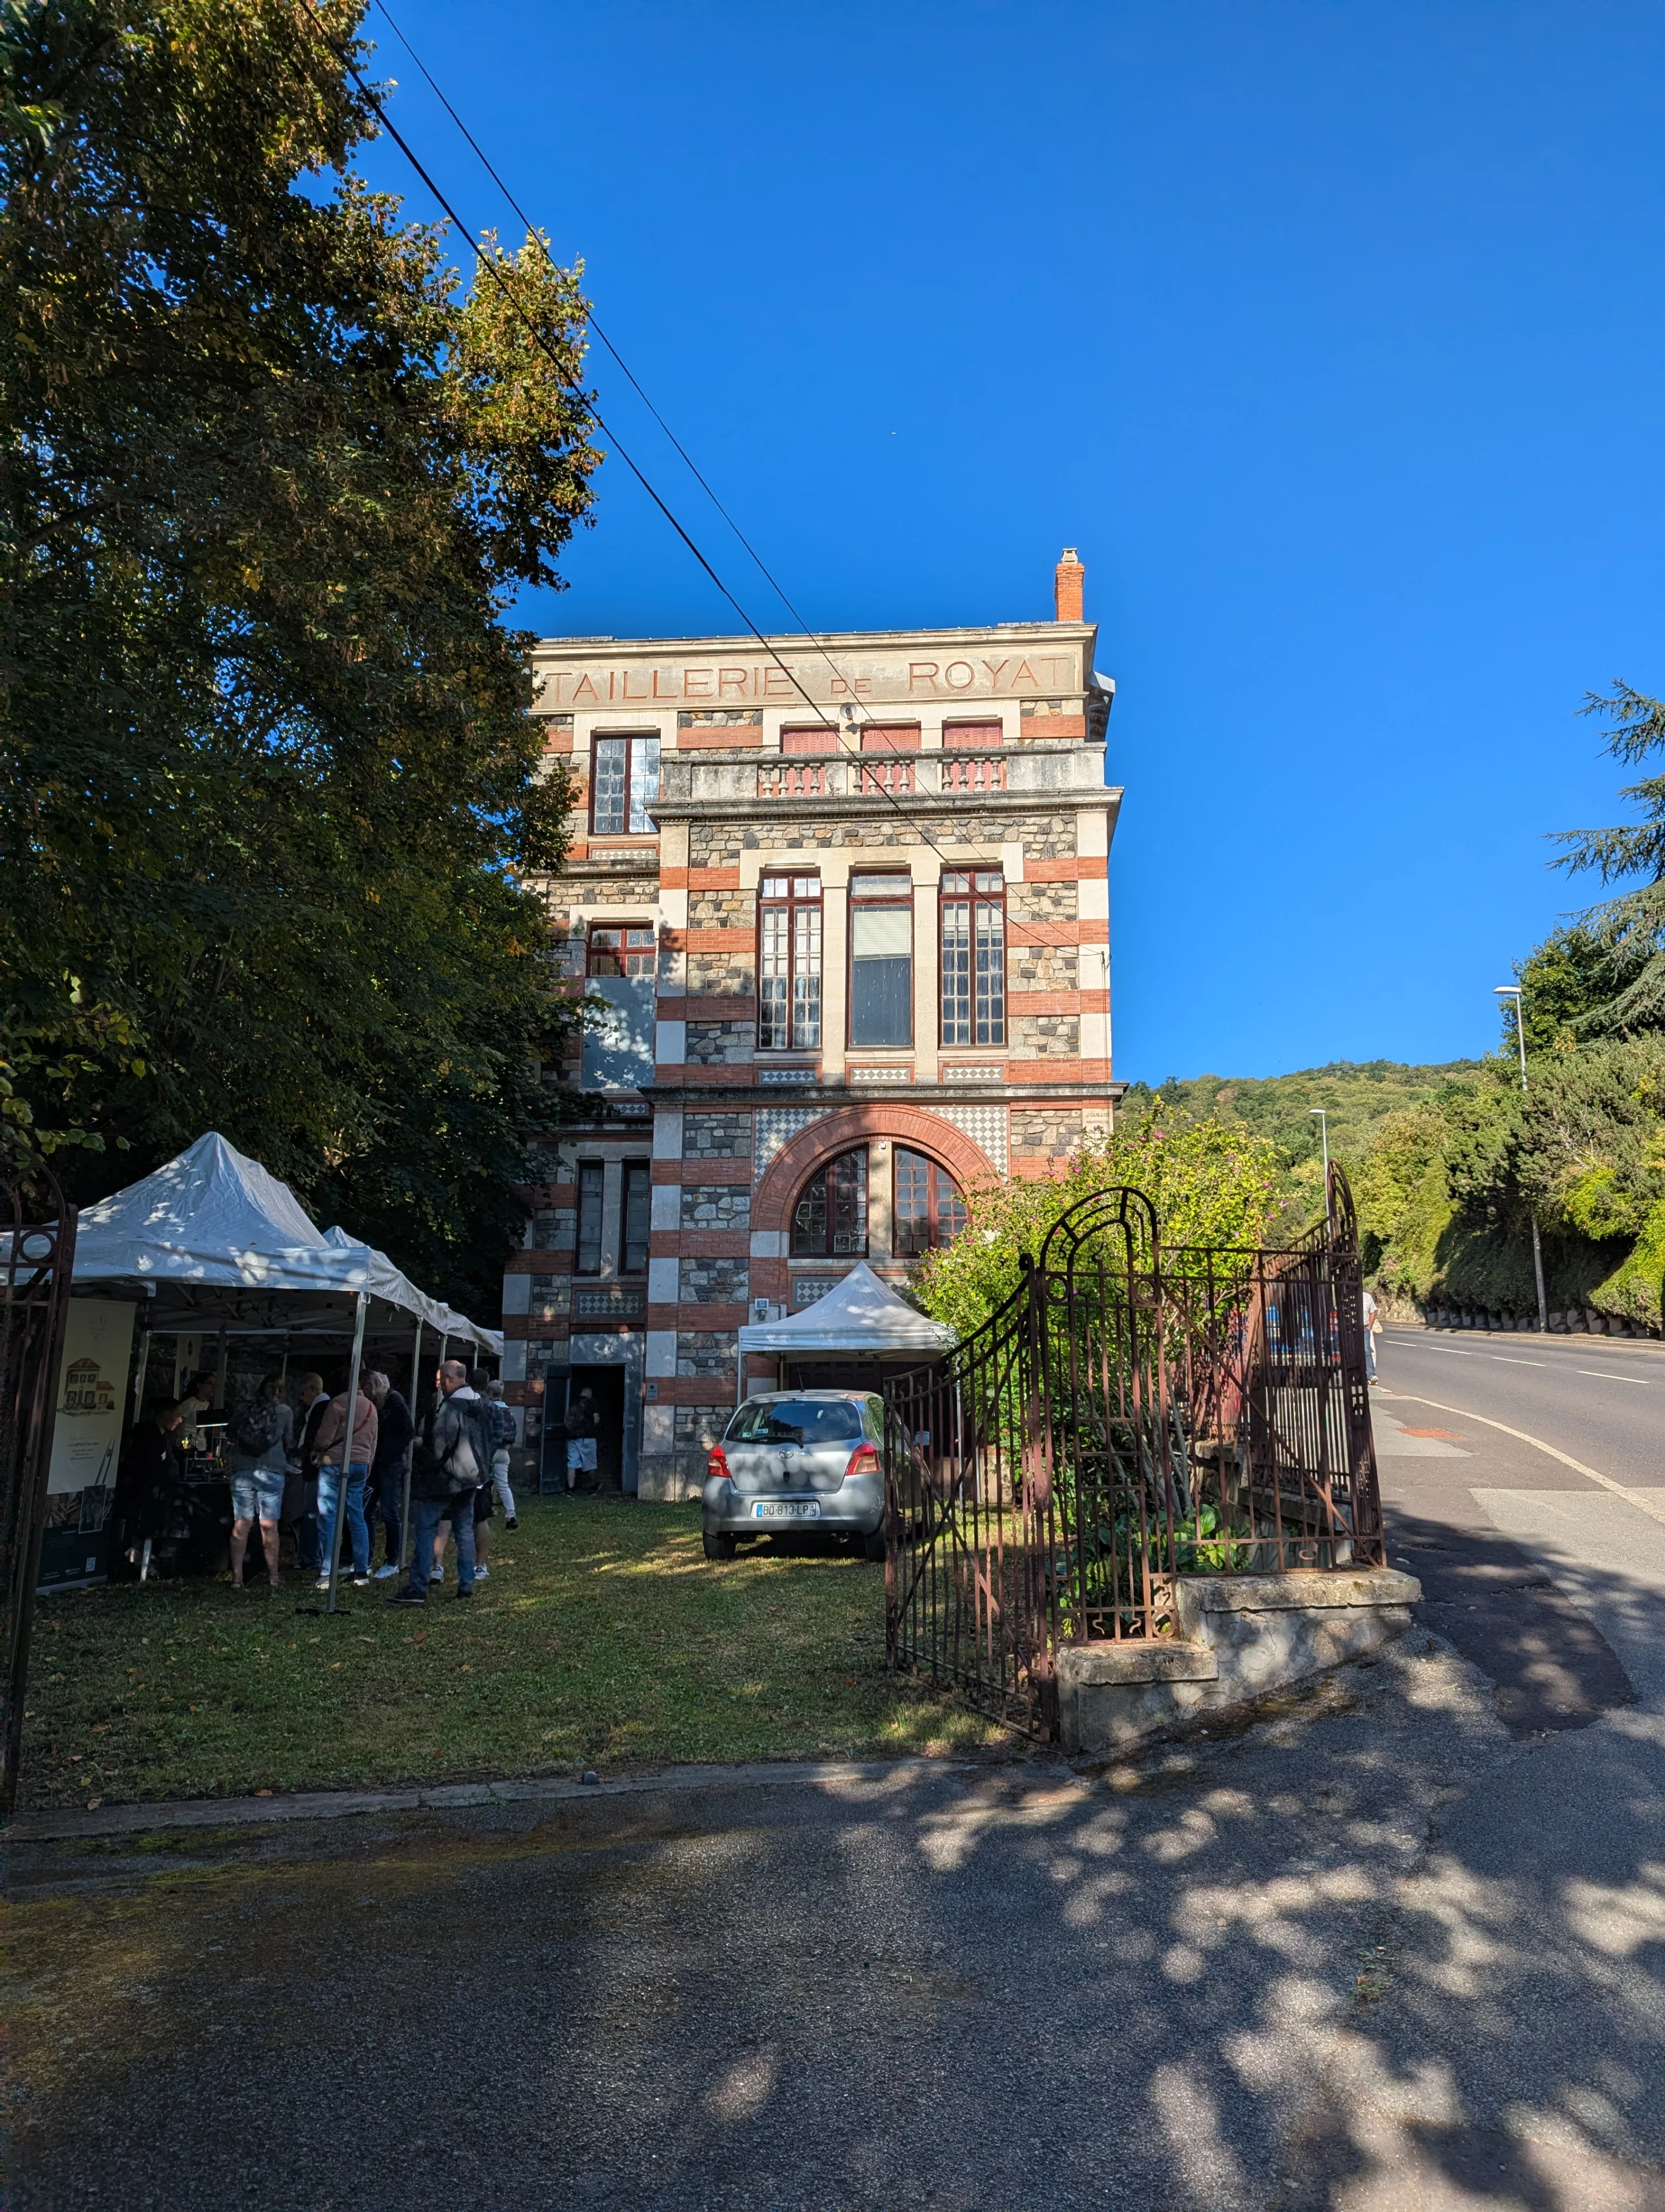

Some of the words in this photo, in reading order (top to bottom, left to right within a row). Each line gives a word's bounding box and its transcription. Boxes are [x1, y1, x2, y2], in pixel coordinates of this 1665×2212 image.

[545, 666, 796, 702] TAILLERIE
[830, 678, 872, 695] DE
[908, 656, 1069, 692] ROYAT
